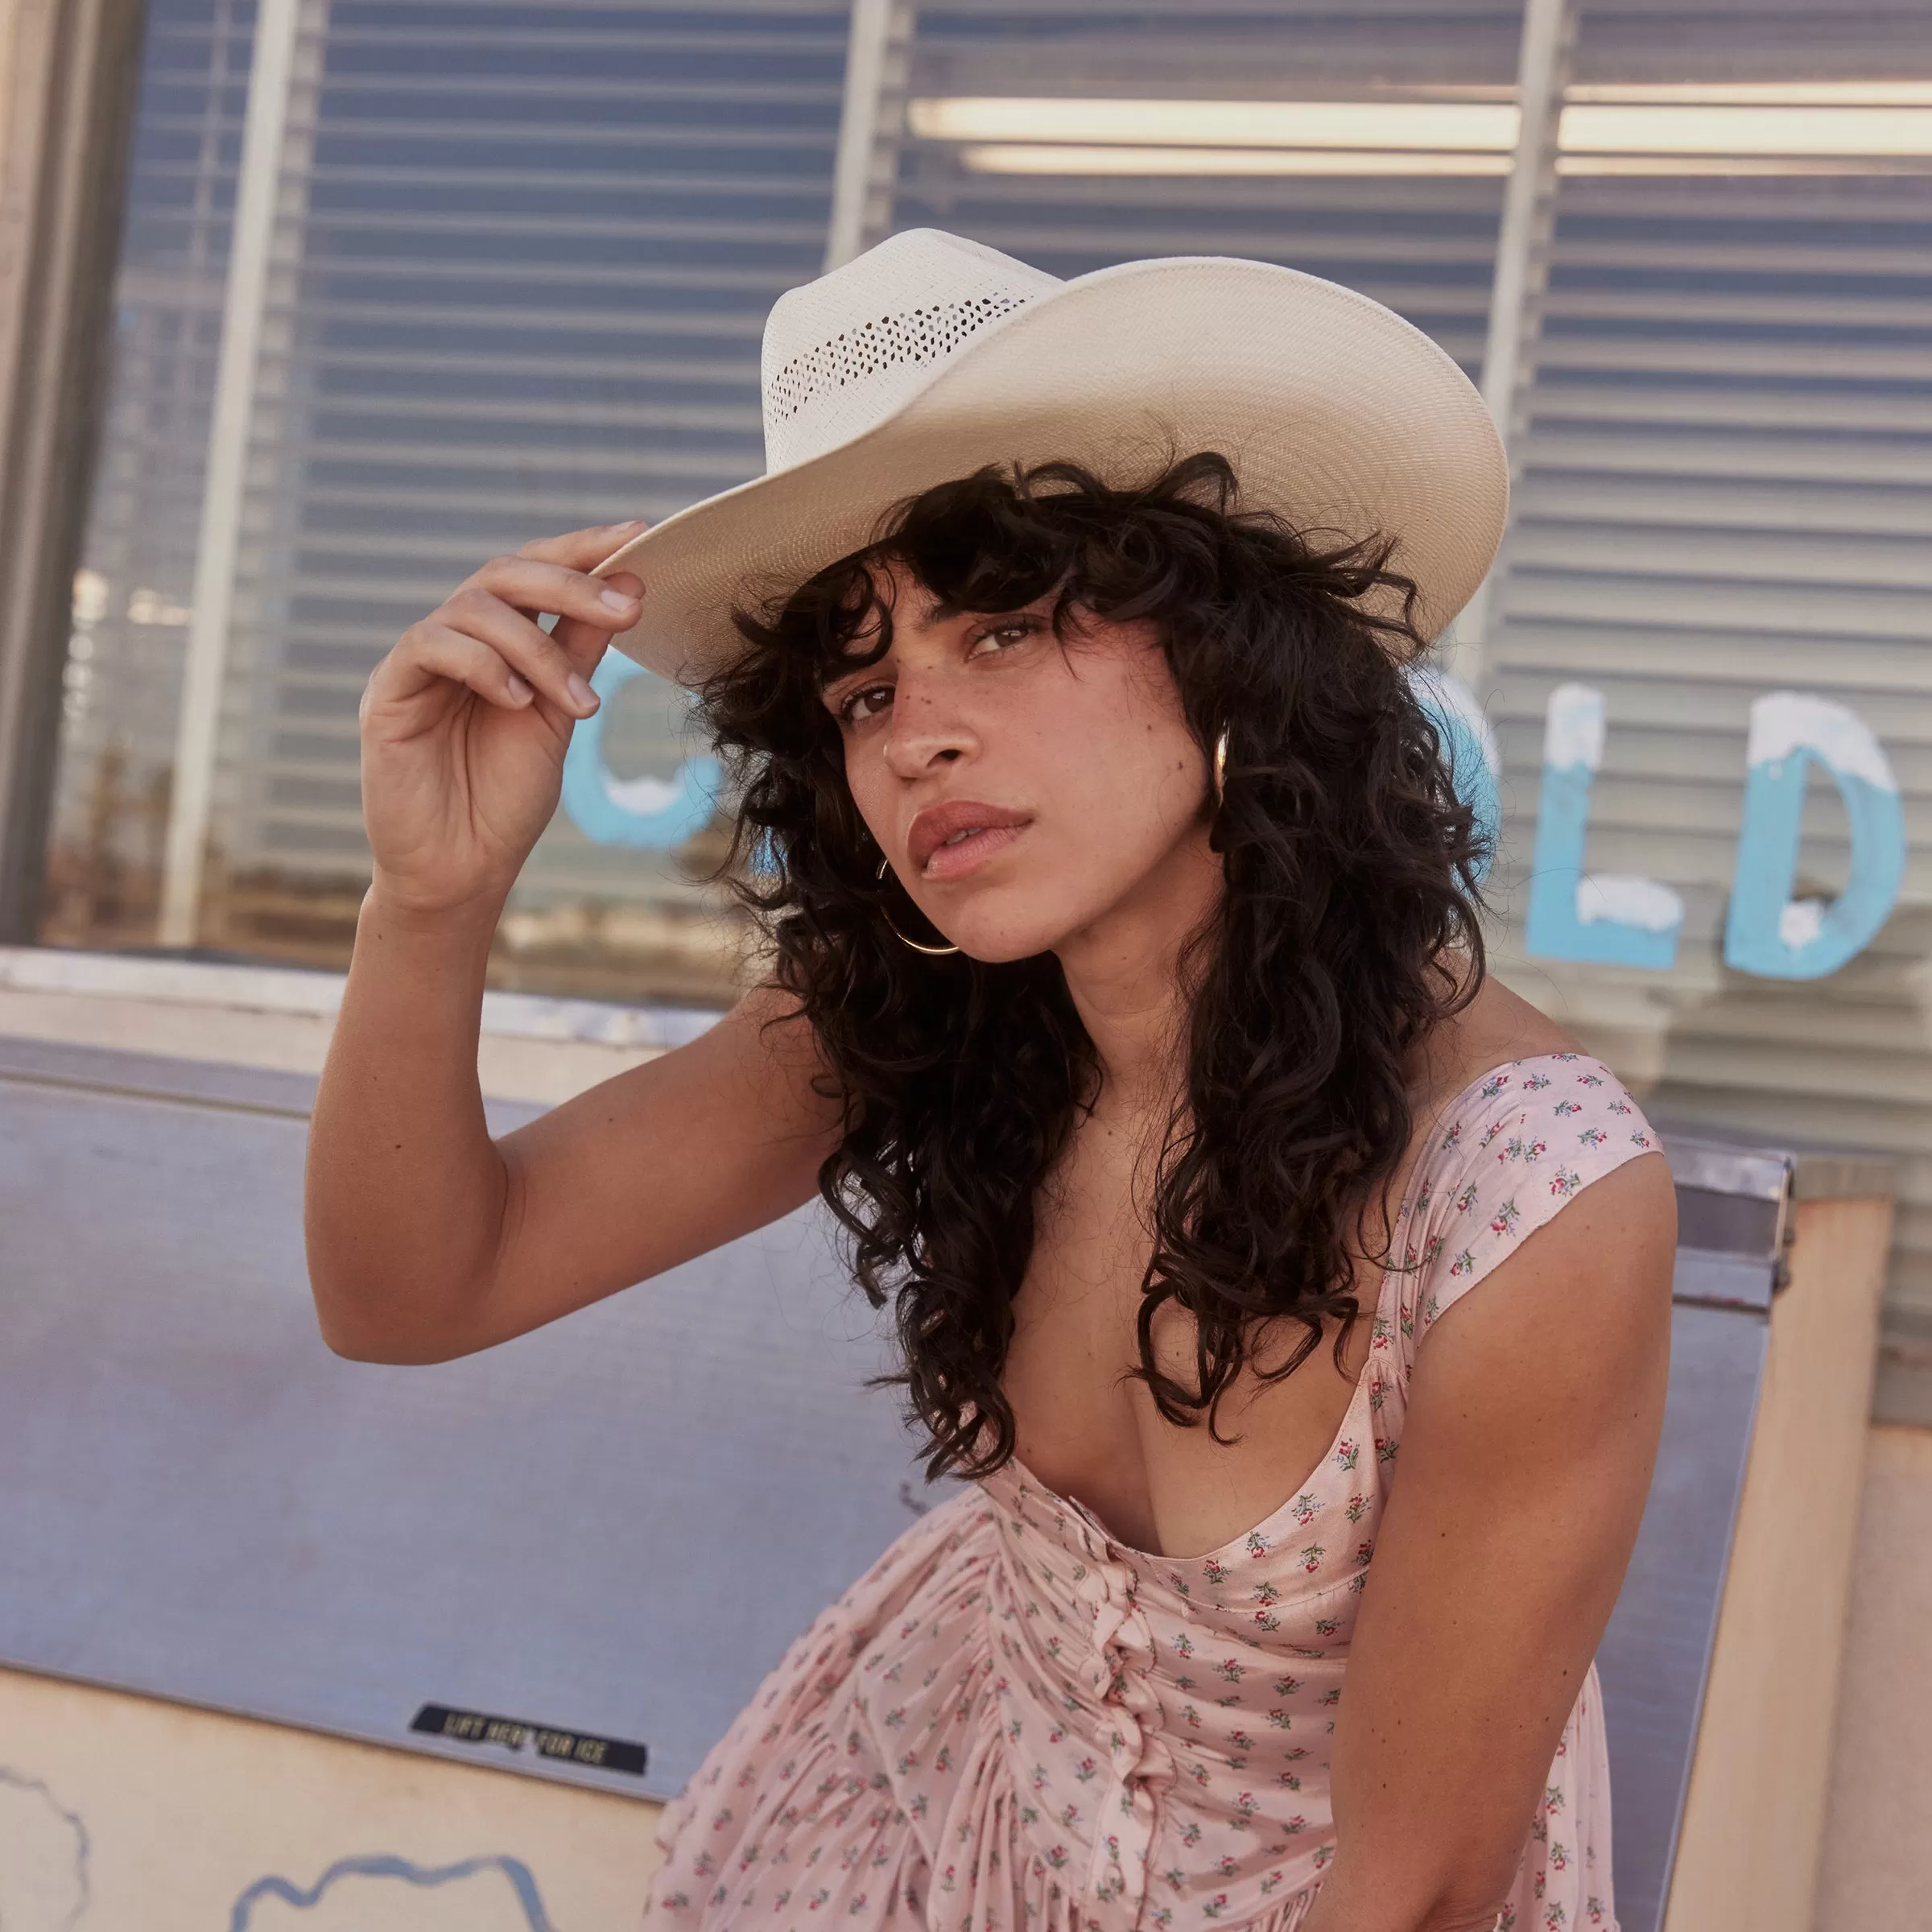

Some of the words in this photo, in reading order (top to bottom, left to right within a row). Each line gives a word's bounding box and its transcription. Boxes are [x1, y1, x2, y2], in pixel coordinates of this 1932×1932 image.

[444, 1712, 485, 1739] LIFT
[485, 1720, 531, 1747] HER
[535, 1730, 575, 1758] FOR
[574, 1736, 609, 1765] ICE
